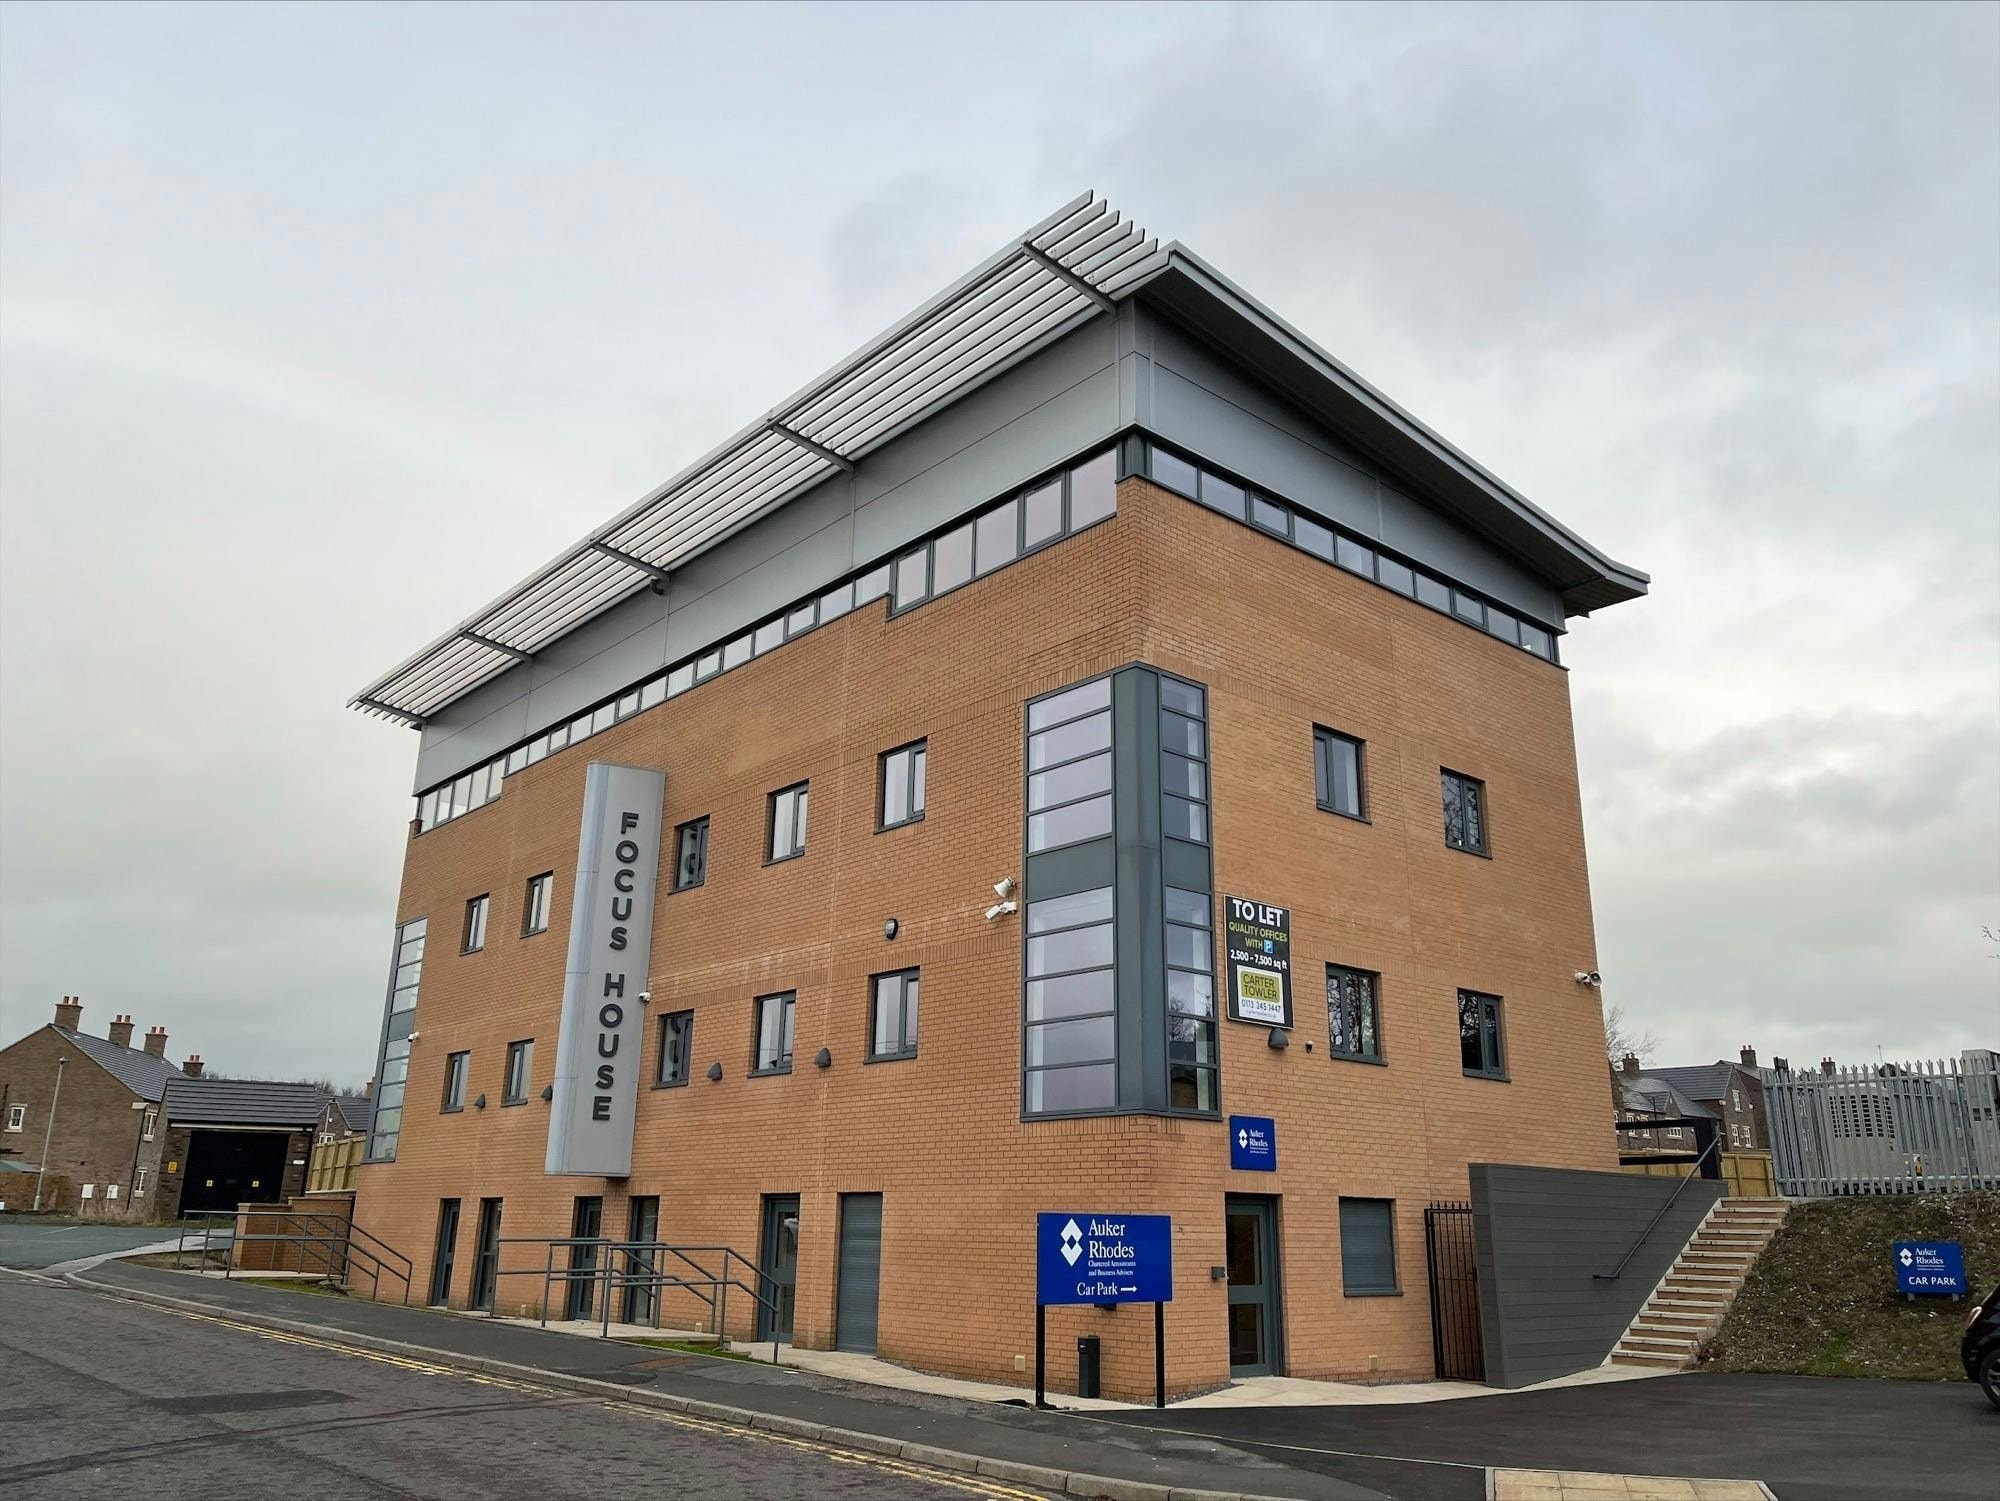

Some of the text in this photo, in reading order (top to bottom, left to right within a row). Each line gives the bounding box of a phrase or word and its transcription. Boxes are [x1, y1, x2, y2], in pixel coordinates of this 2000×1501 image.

[1233, 899, 1283, 927] TO LET
[1229, 921, 1287, 943] QUALITY OFFICES
[1245, 937, 1263, 950] WITH
[592, 811, 639, 1122] FOCUS HOUSE
[1230, 949, 1249, 962] 2,500
[1254, 954, 1272, 967] 7,500
[1273, 960, 1281, 970] sq
[1282, 960, 1287, 970] ft
[1243, 973, 1275, 989] CARTER
[1244, 984, 1277, 1000] TOWLER
[1241, 999, 1281, 1013] 0113 245 1447
[1249, 1129, 1264, 1138] Auker
[1249, 1138, 1269, 1147] Rhodes
[1088, 1218, 1126, 1236] Auker
[1089, 1240, 1135, 1259] Rhodes
[1915, 1248, 1937, 1256] Auker
[1916, 1256, 1944, 1265] Rhodes
[1077, 1281, 1119, 1296] Car Park
[1908, 1276, 1957, 1286] CAR PARK
